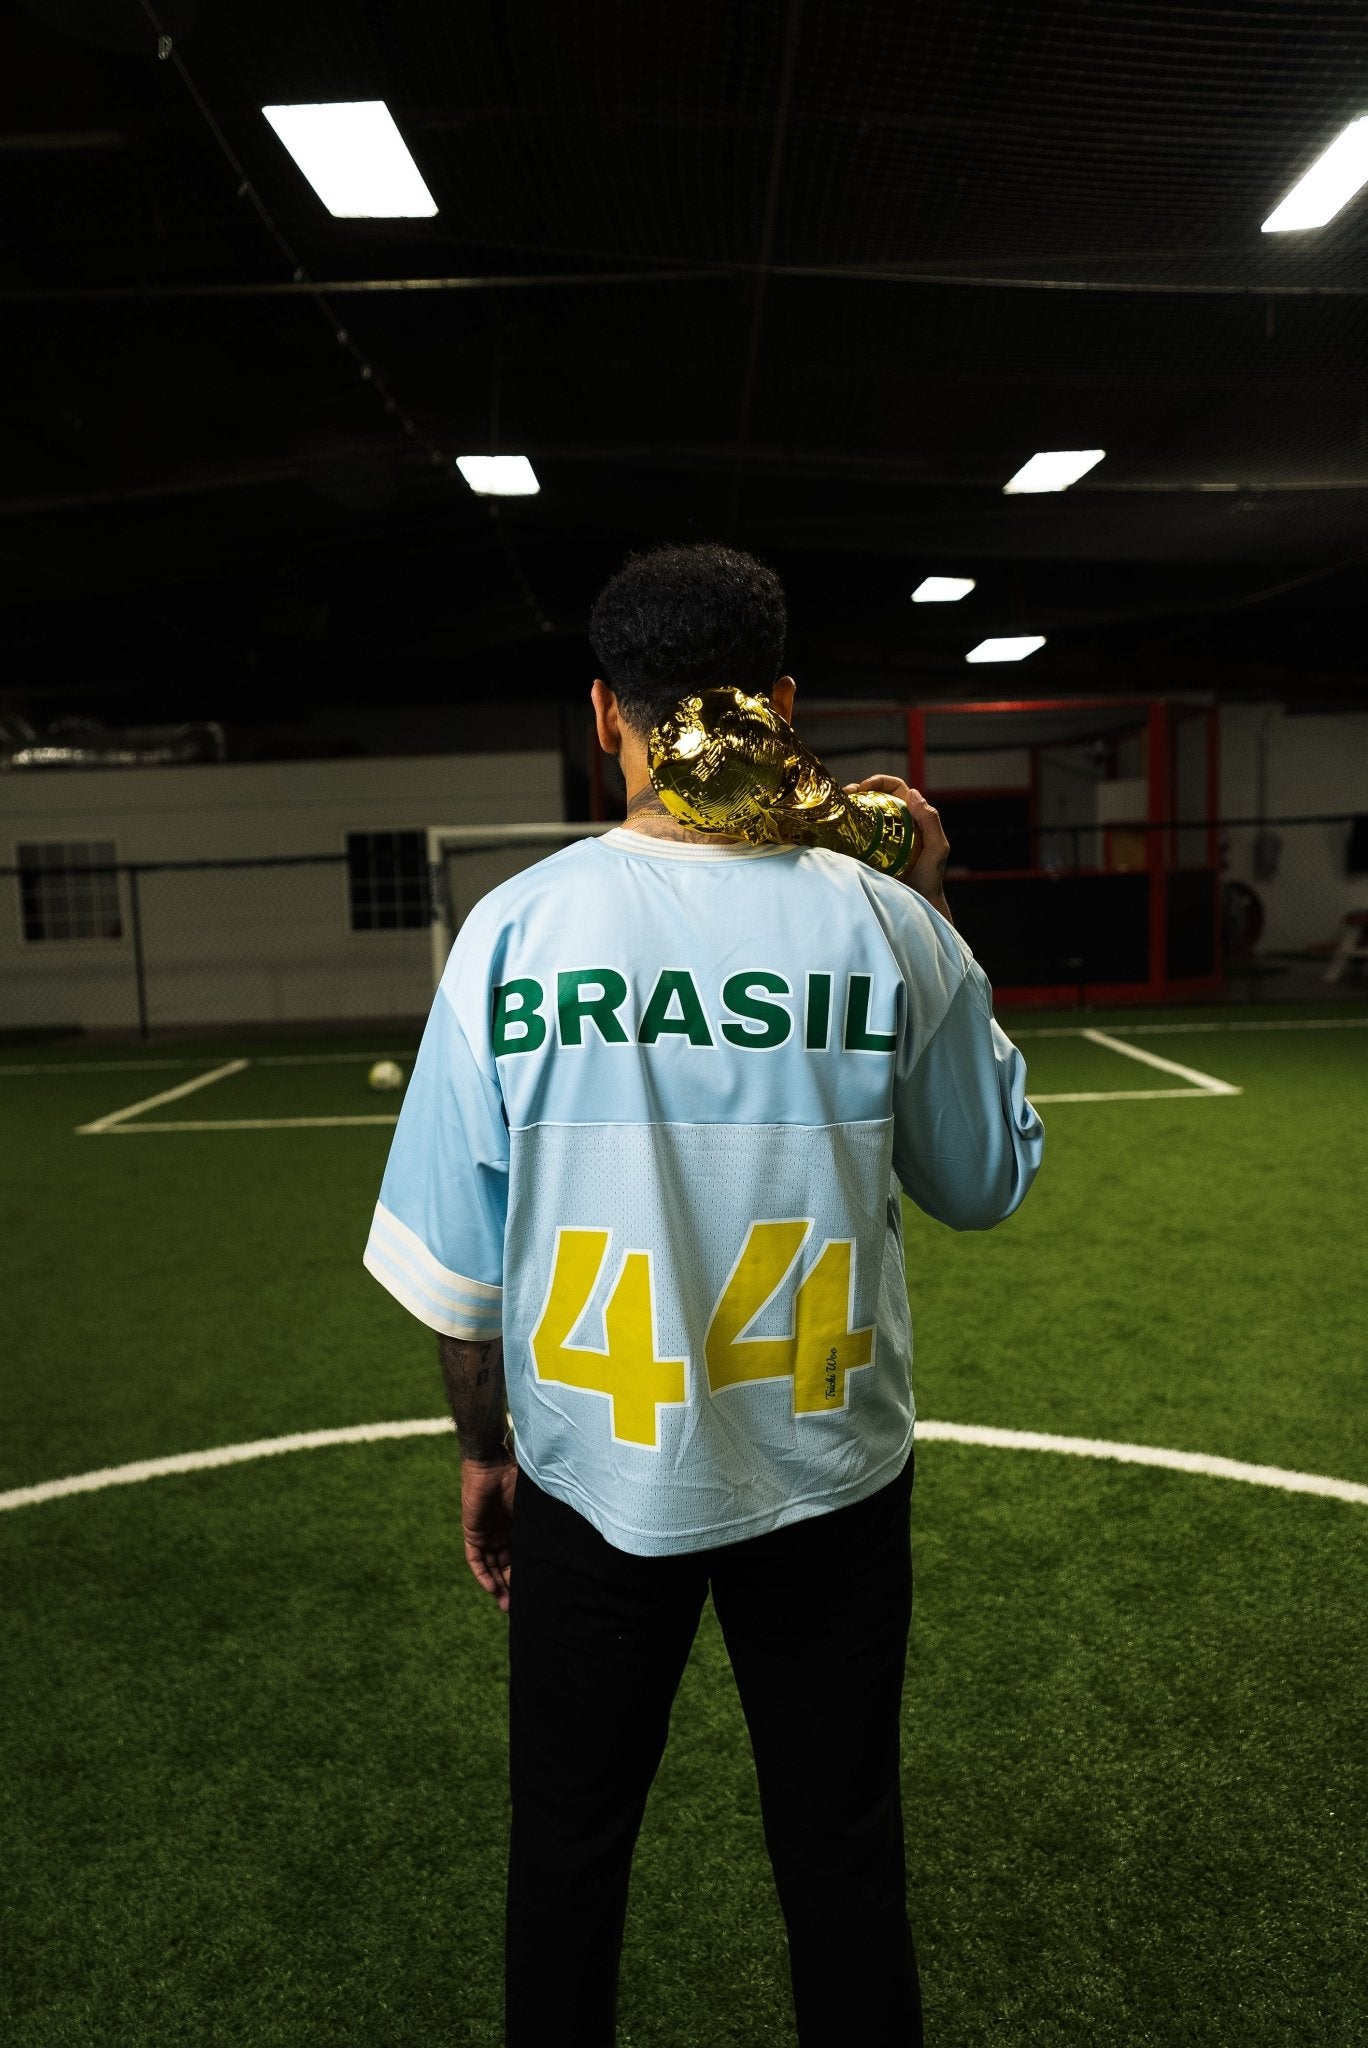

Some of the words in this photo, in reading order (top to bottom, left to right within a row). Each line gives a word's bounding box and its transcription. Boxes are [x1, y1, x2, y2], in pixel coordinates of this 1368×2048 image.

[493, 966, 898, 1058] BRASIL
[529, 1217, 877, 1451] 44
[826, 1347, 837, 1372] Woo
